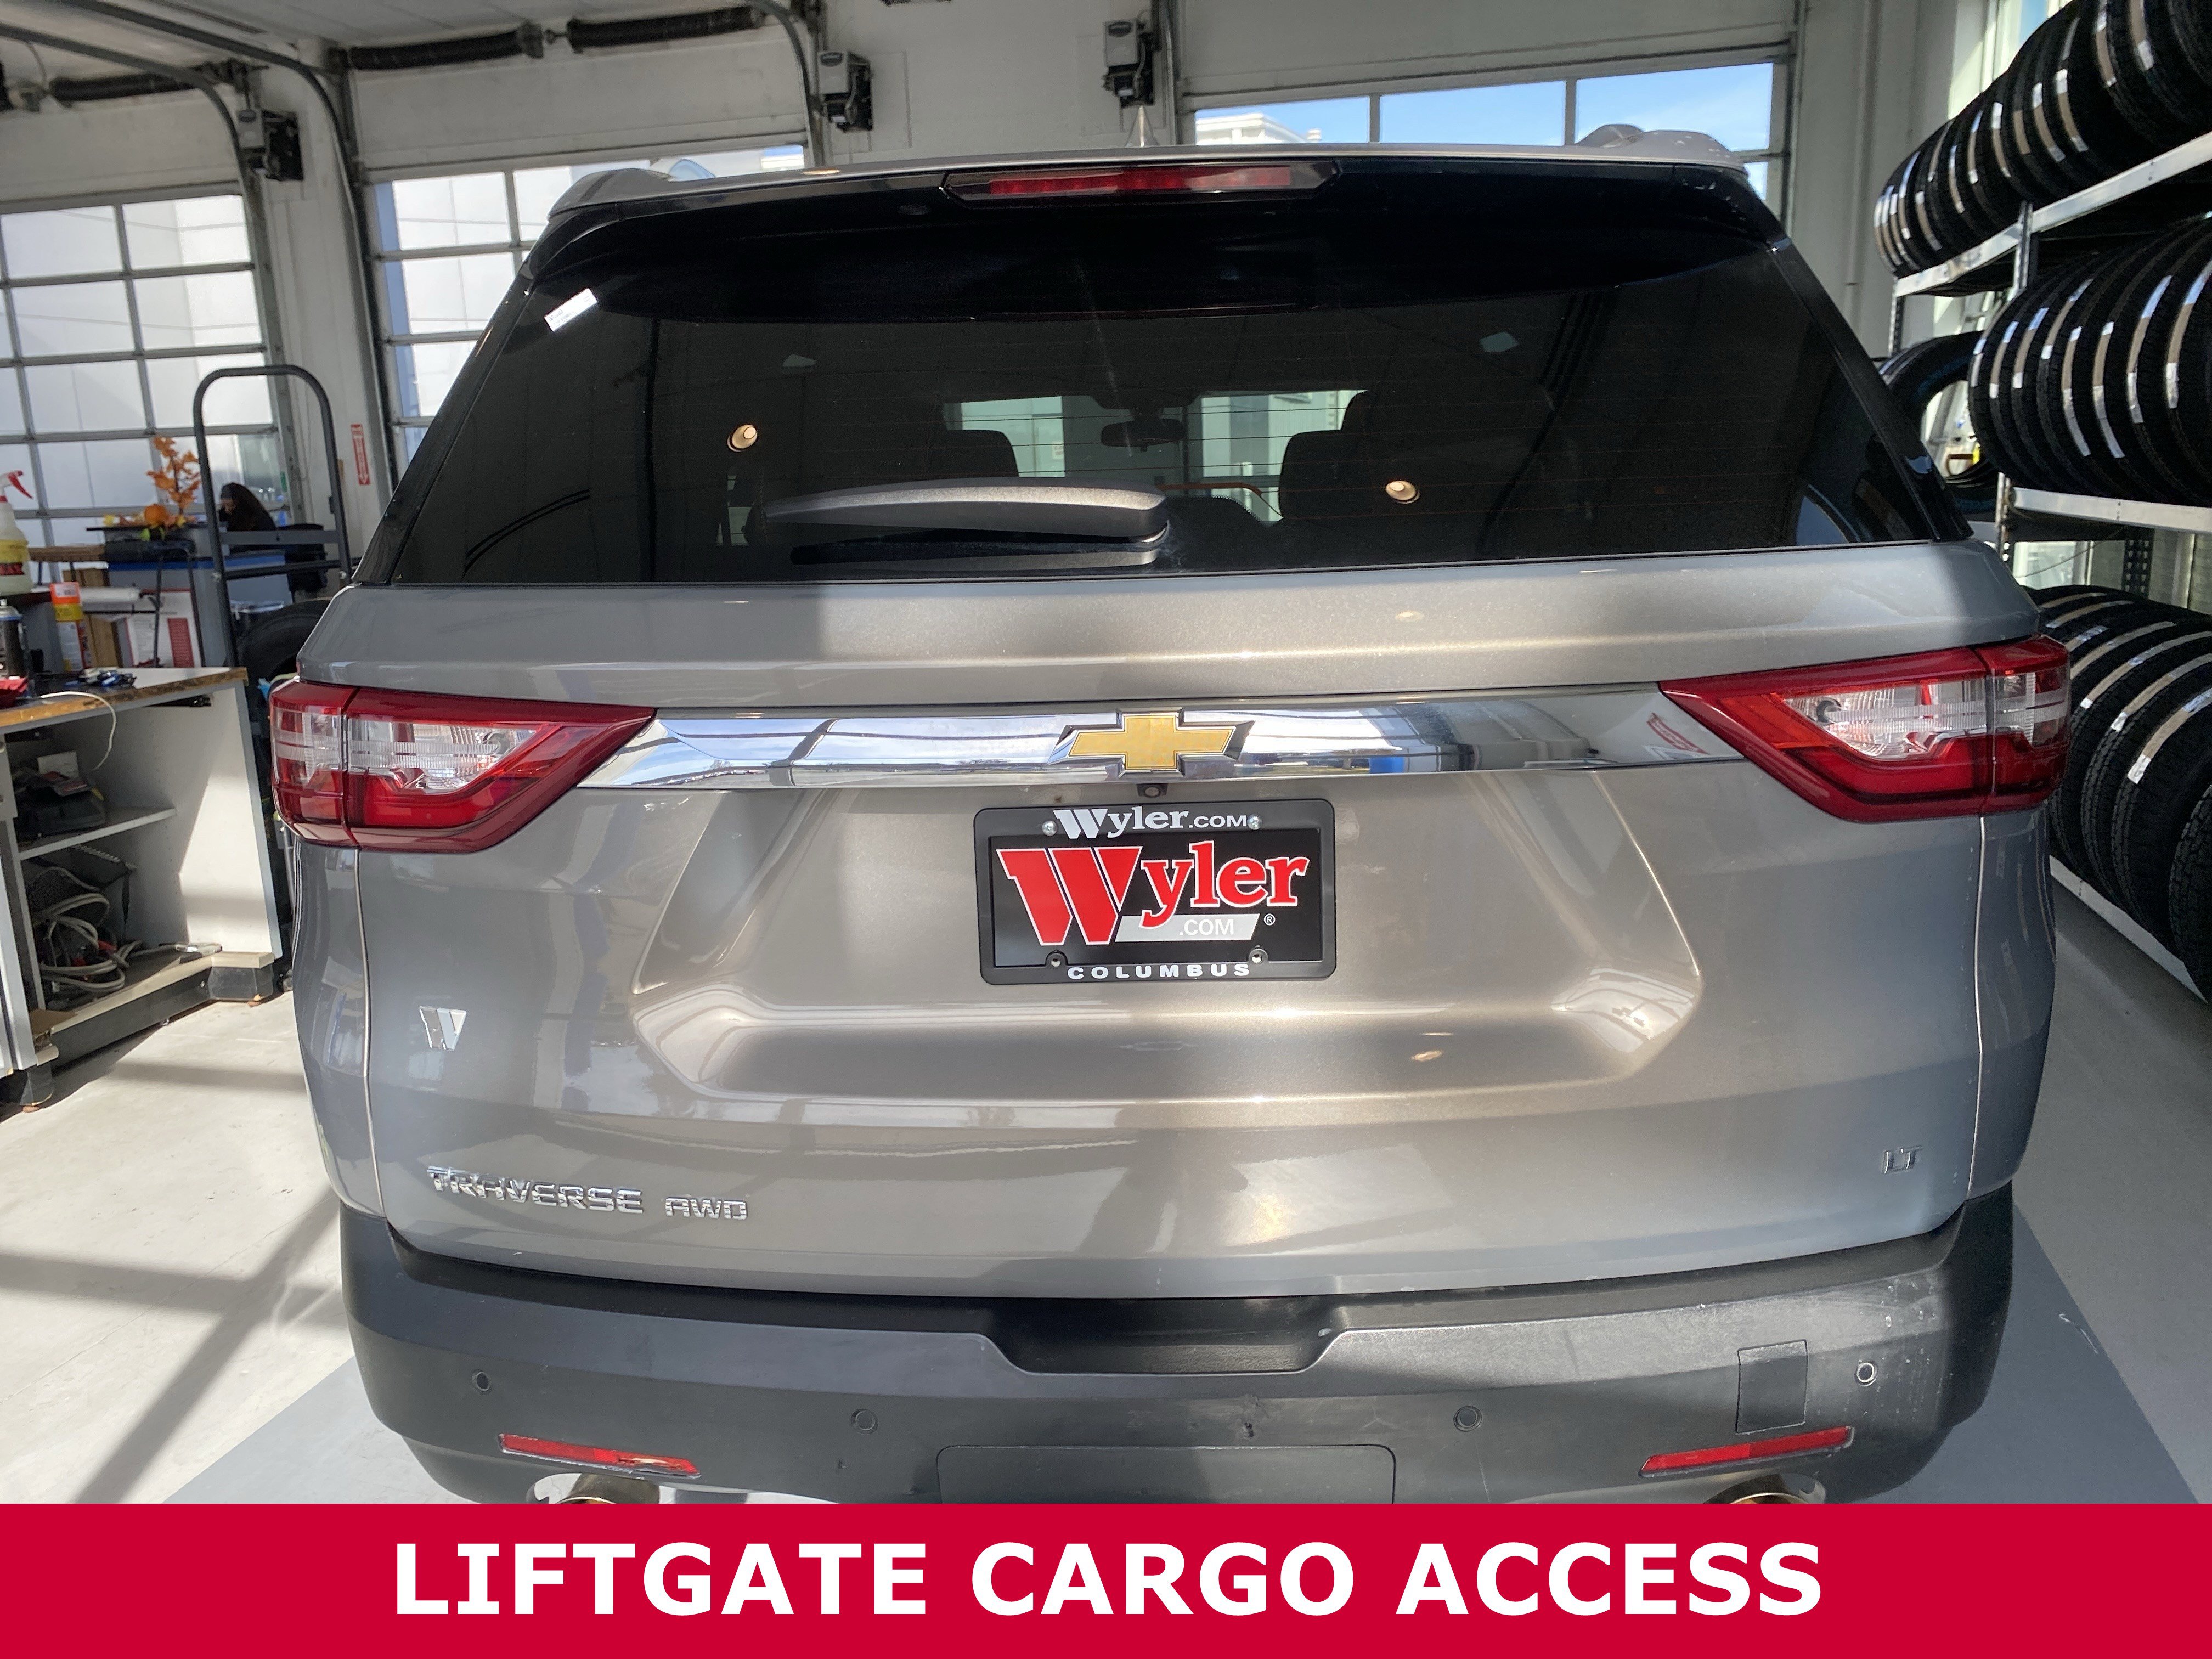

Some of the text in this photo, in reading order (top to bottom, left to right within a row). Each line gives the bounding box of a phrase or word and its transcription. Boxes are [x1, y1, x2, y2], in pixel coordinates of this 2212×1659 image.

[996, 840, 1310, 946] Wyler
[1066, 963, 1250, 980] COLUMBUS
[1882, 1144, 1922, 1175] LT
[426, 1165, 748, 1221] TRAVERSE AWD
